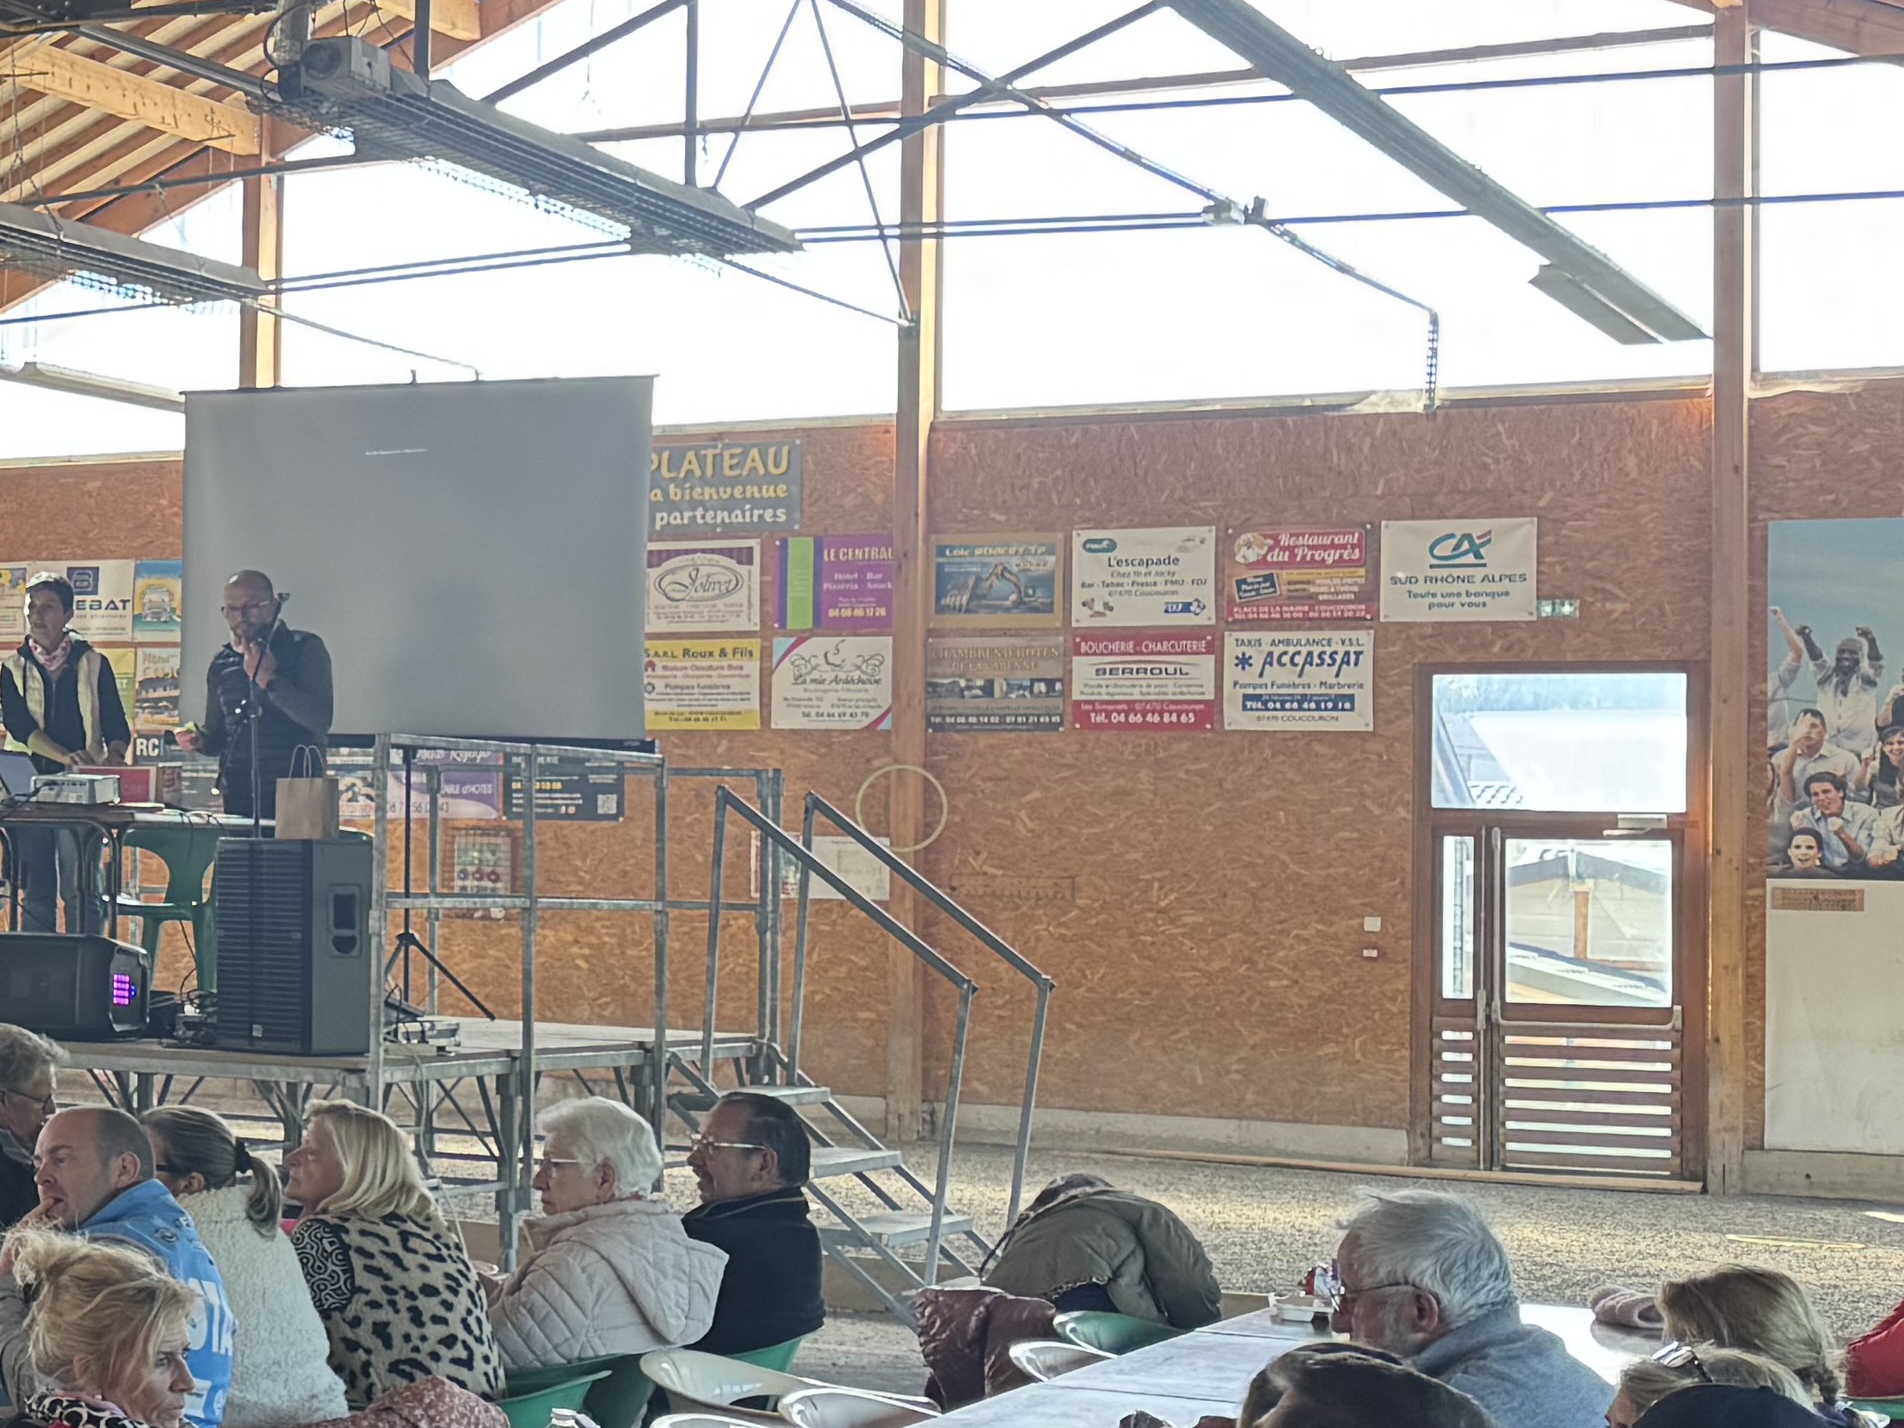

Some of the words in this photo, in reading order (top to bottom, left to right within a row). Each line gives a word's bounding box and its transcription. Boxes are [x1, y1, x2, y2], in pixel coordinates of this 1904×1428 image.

[669, 482, 789, 502] bienvenue
[654, 504, 788, 531] partenaires
[1278, 532, 1359, 547] Restaurant
[1429, 529, 1492, 561] CA
[823, 548, 837, 562] LE
[839, 546, 893, 562] CENTRAL
[1266, 548, 1289, 562] du
[1294, 544, 1360, 565] Progrès
[1107, 554, 1181, 569] L'escapade
[1080, 581, 1095, 589] Bar
[1101, 580, 1125, 588] Tabac
[1131, 580, 1158, 588] Presse
[1389, 575, 1419, 585] SUD
[1423, 573, 1476, 585] RHÔNE
[1480, 573, 1527, 584] ALPES
[1407, 590, 1438, 599] Toute
[1465, 589, 1511, 600] banque
[75, 599, 131, 611] EBAT
[1428, 601, 1456, 610] pour
[1080, 641, 1135, 654] BOUCHERIE
[1141, 639, 1207, 653] CHARCUTERIE
[1234, 638, 1262, 648] TAXIS
[1269, 637, 1333, 647] AMBULANCE
[1340, 637, 1364, 647] V.S.L.
[682, 647, 715, 658] Roux
[718, 647, 728, 658] &
[732, 647, 754, 658] Fils
[1258, 650, 1365, 679] ACCASSAT
[1233, 680, 1268, 690] Pompes
[1270, 680, 1311, 689] Funèbres
[1319, 680, 1364, 689] Marbrerie
[1090, 713, 1109, 724] Tél.
[1111, 712, 1126, 724] 04
[1128, 712, 1143, 724] 66
[1145, 712, 1161, 724] 46
[1163, 712, 1178, 724] 84
